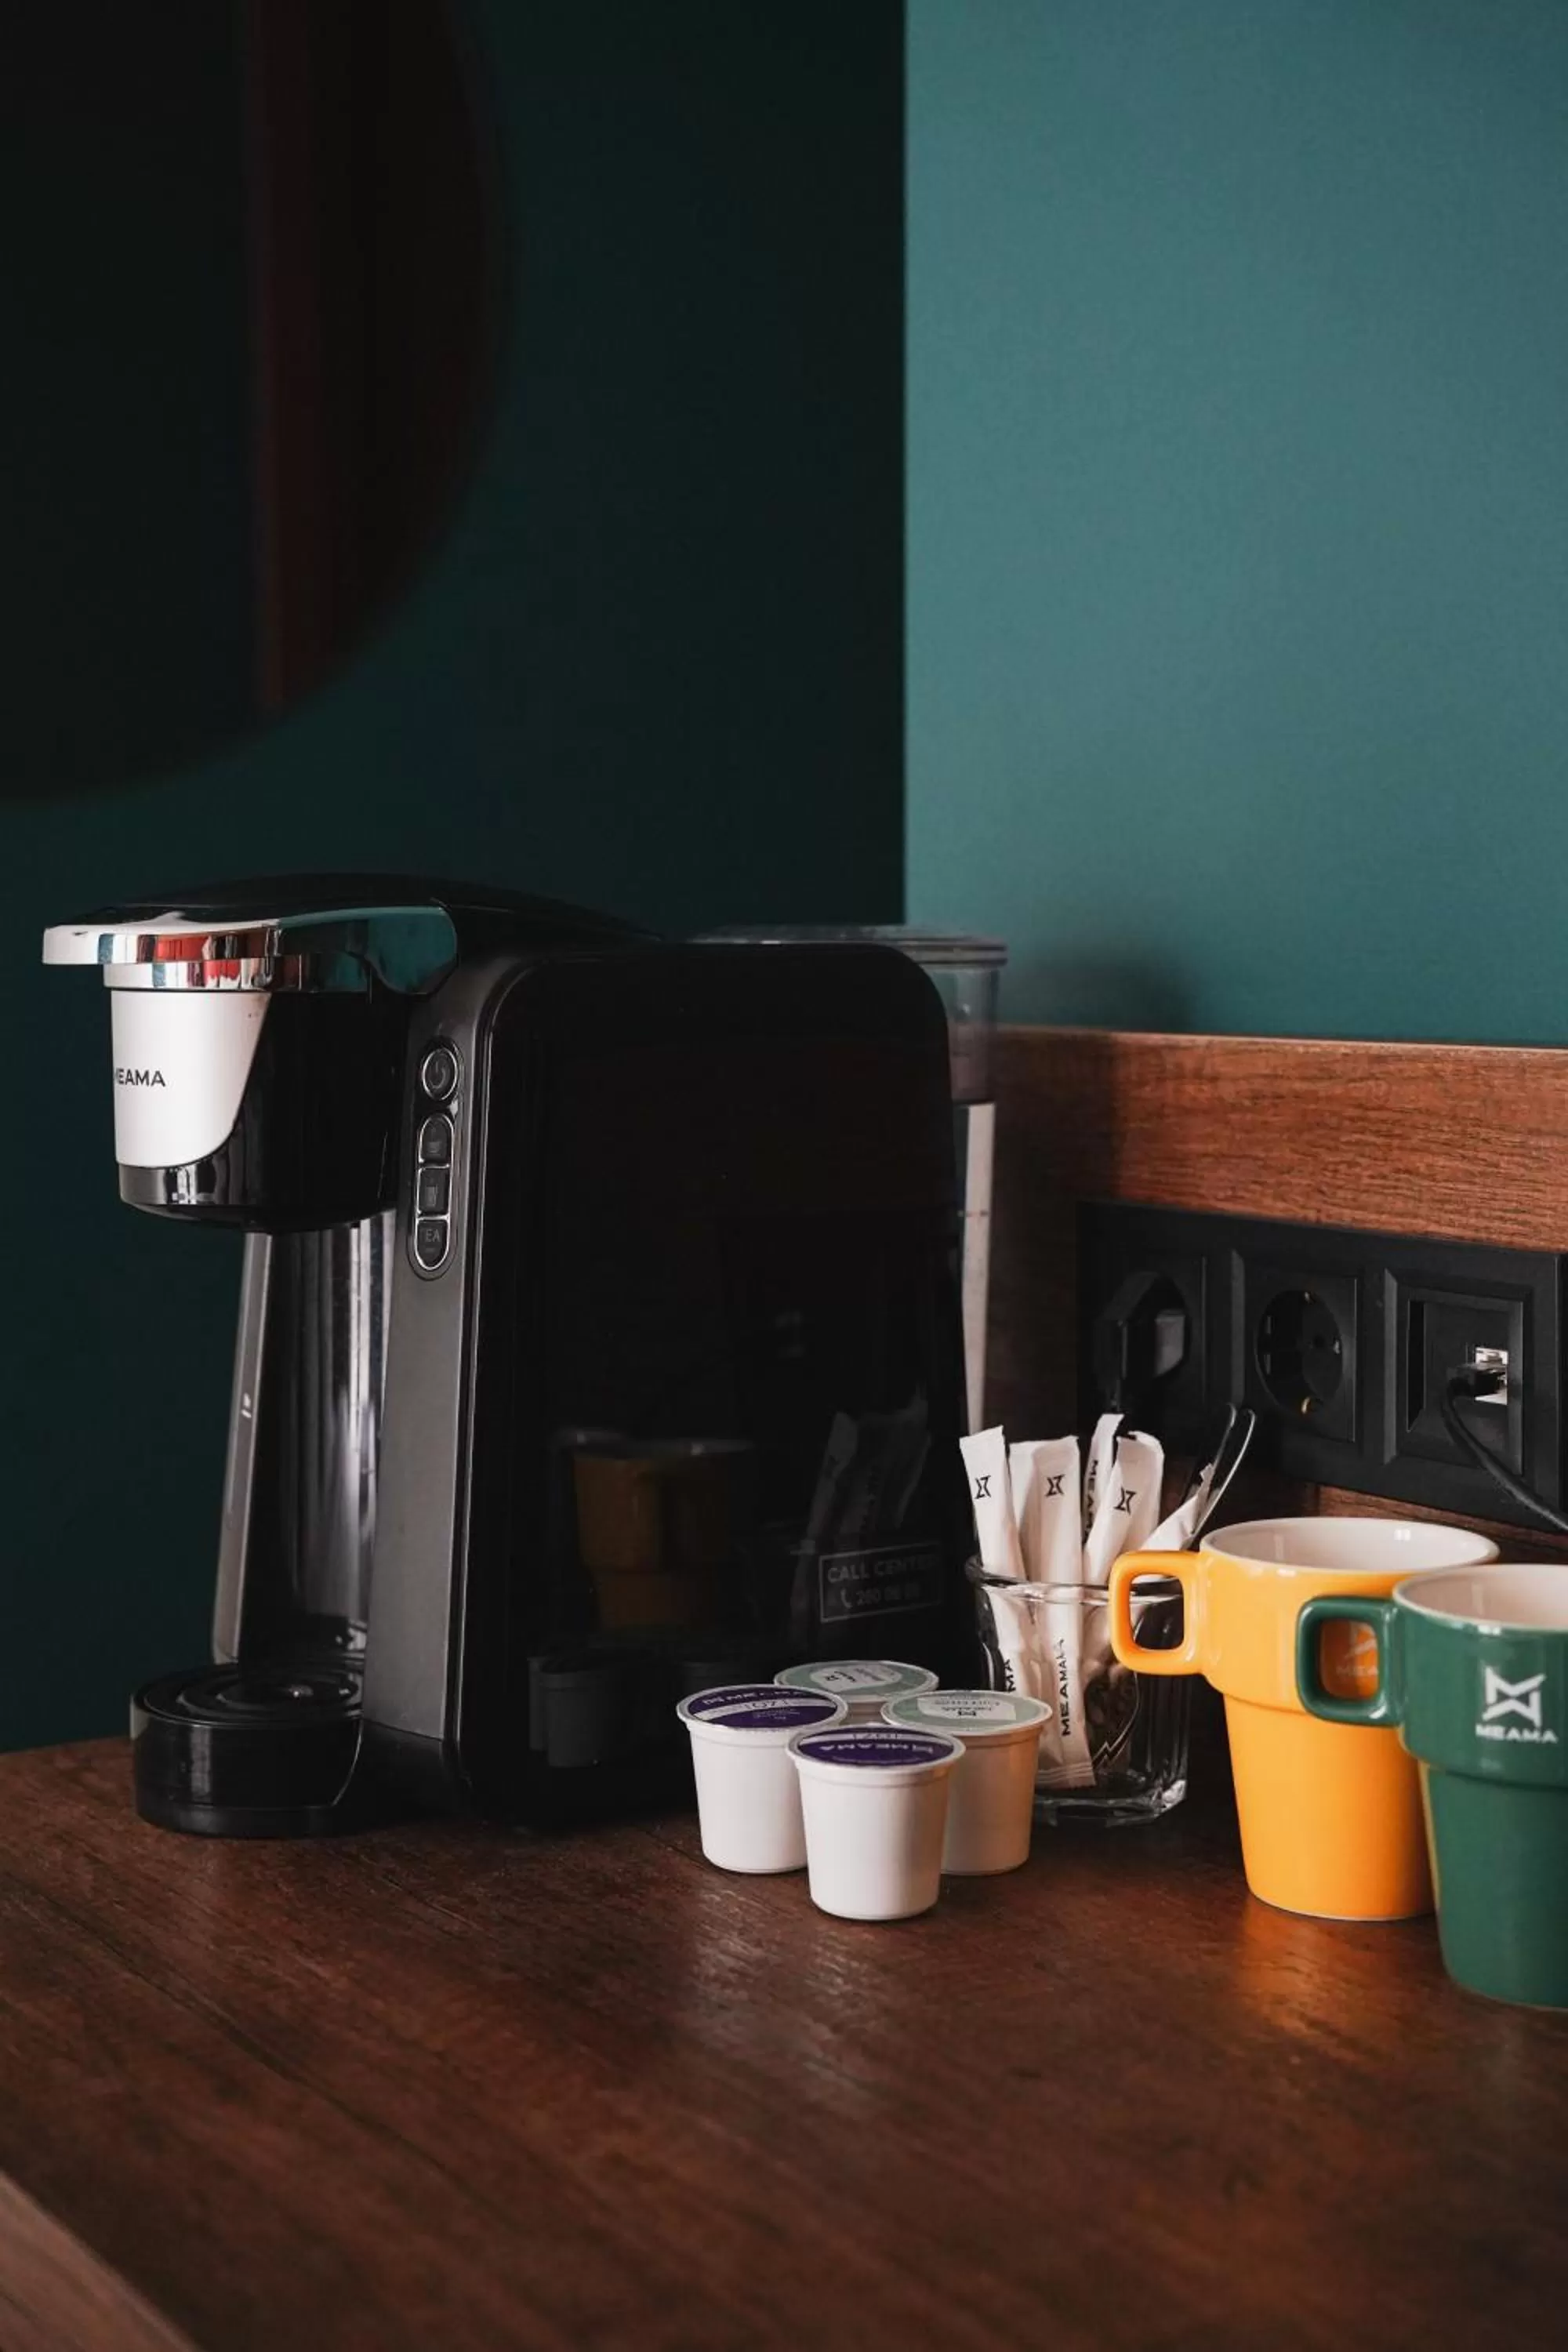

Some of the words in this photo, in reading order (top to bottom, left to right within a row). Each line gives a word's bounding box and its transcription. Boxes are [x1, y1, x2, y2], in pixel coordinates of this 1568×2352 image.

[115, 1067, 166, 1087] EAMA
[419, 1228, 441, 1243] EA
[827, 1562, 871, 1584] CALL
[1475, 1724, 1559, 1744] MEAMA
